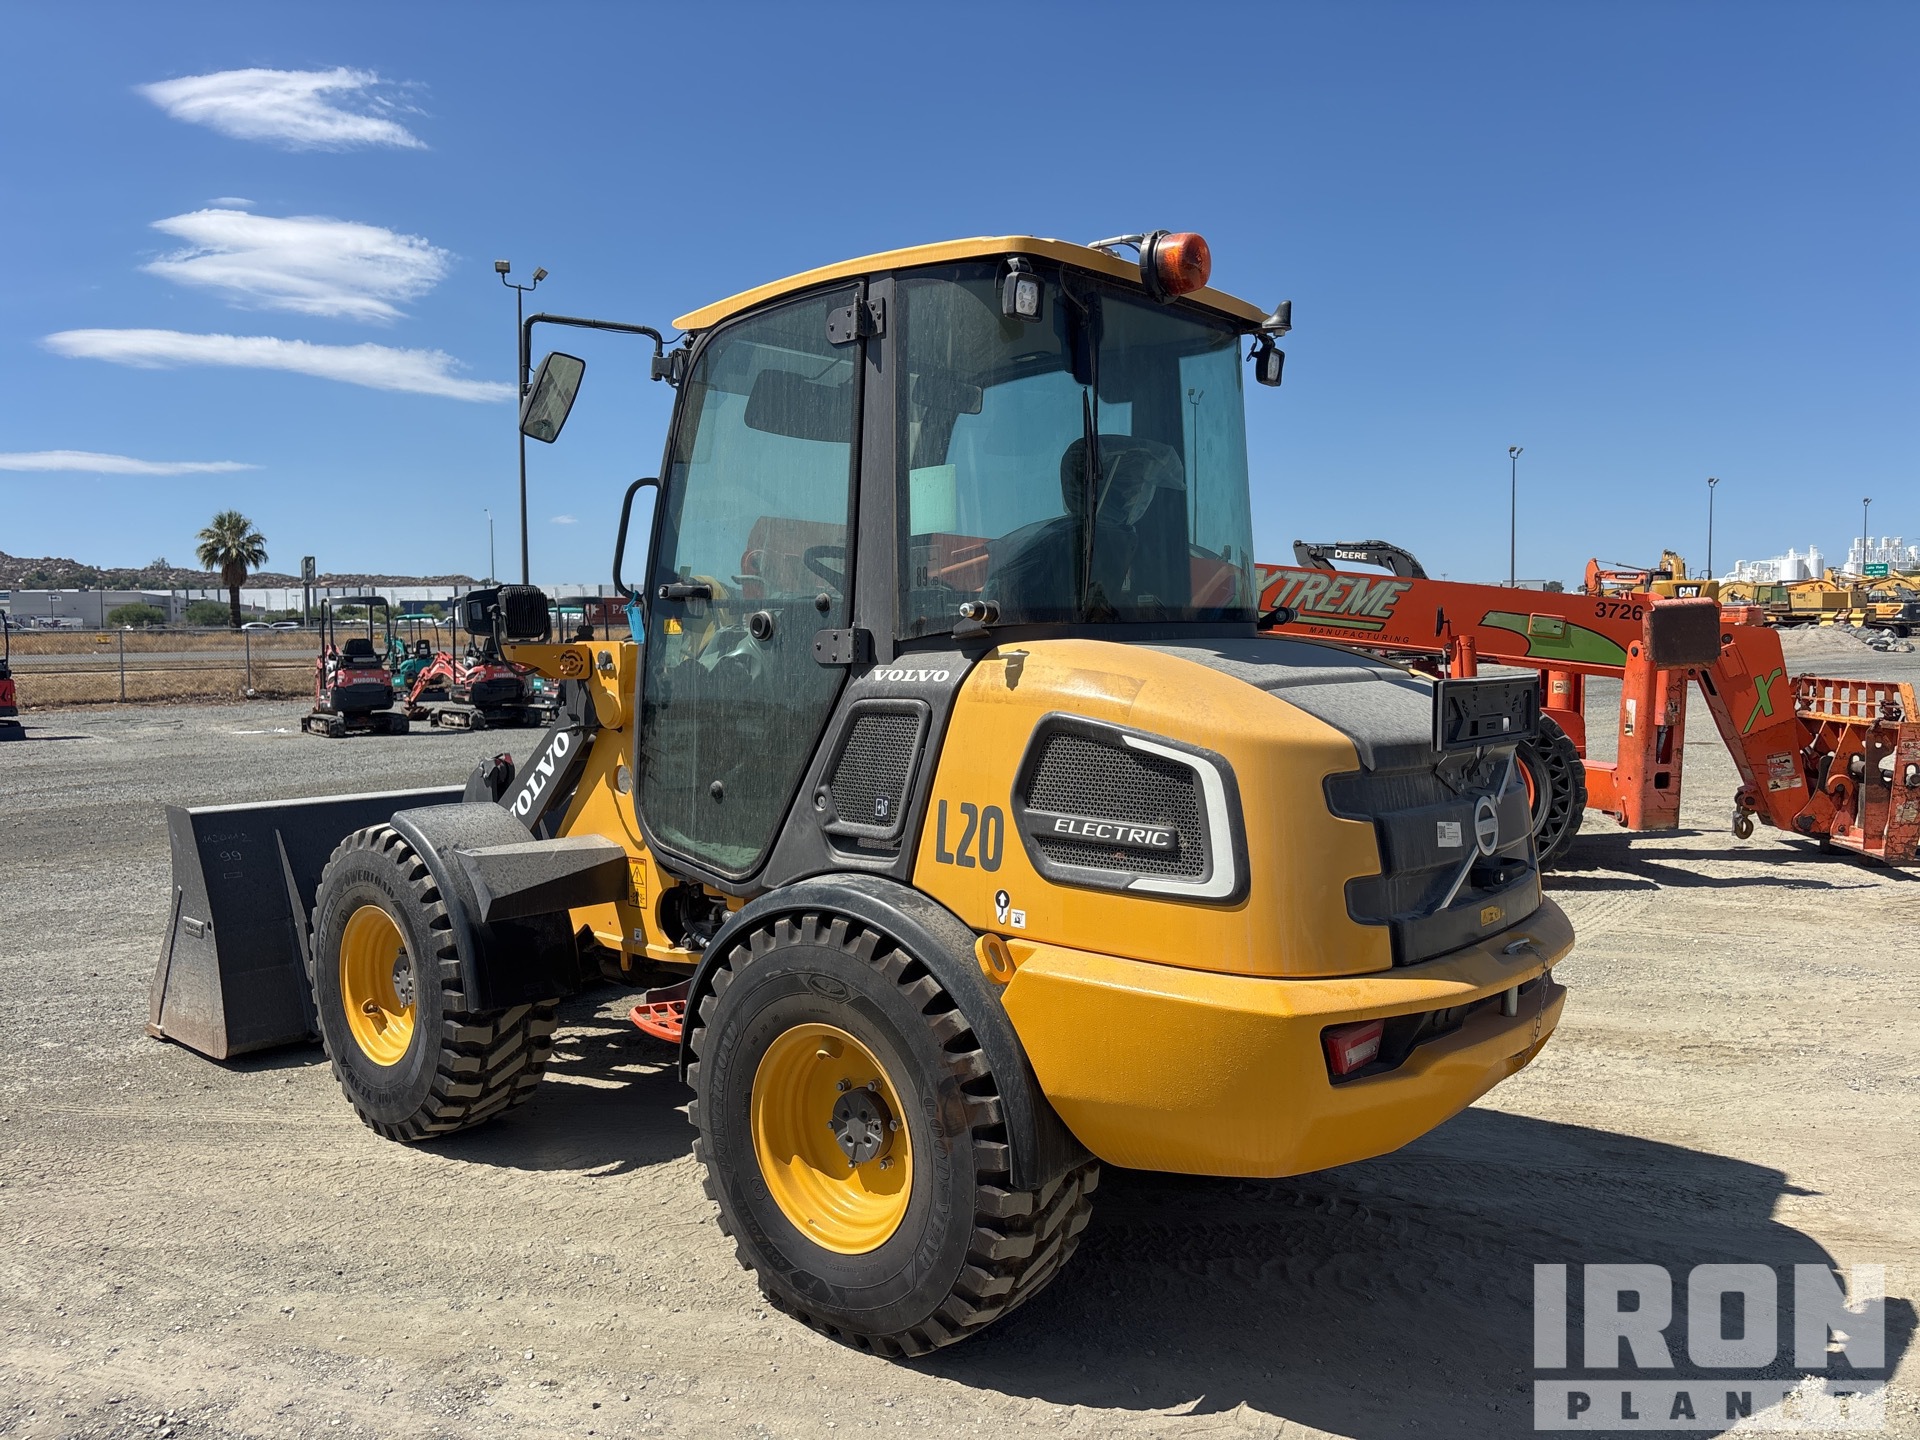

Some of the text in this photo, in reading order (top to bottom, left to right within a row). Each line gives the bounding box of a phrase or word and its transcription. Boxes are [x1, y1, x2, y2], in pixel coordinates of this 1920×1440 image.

[1334, 549, 1368, 560] DEERE
[916, 566, 928, 587] 89
[1679, 587, 1698, 598] CAT
[1594, 601, 1644, 621] 3726
[38, 619, 61, 629] FedE
[1308, 626, 1410, 643] MANUFACTURING
[873, 669, 949, 682] VOLVO
[935, 799, 1005, 873] L20
[1053, 818, 1170, 847] ELECTRIC
